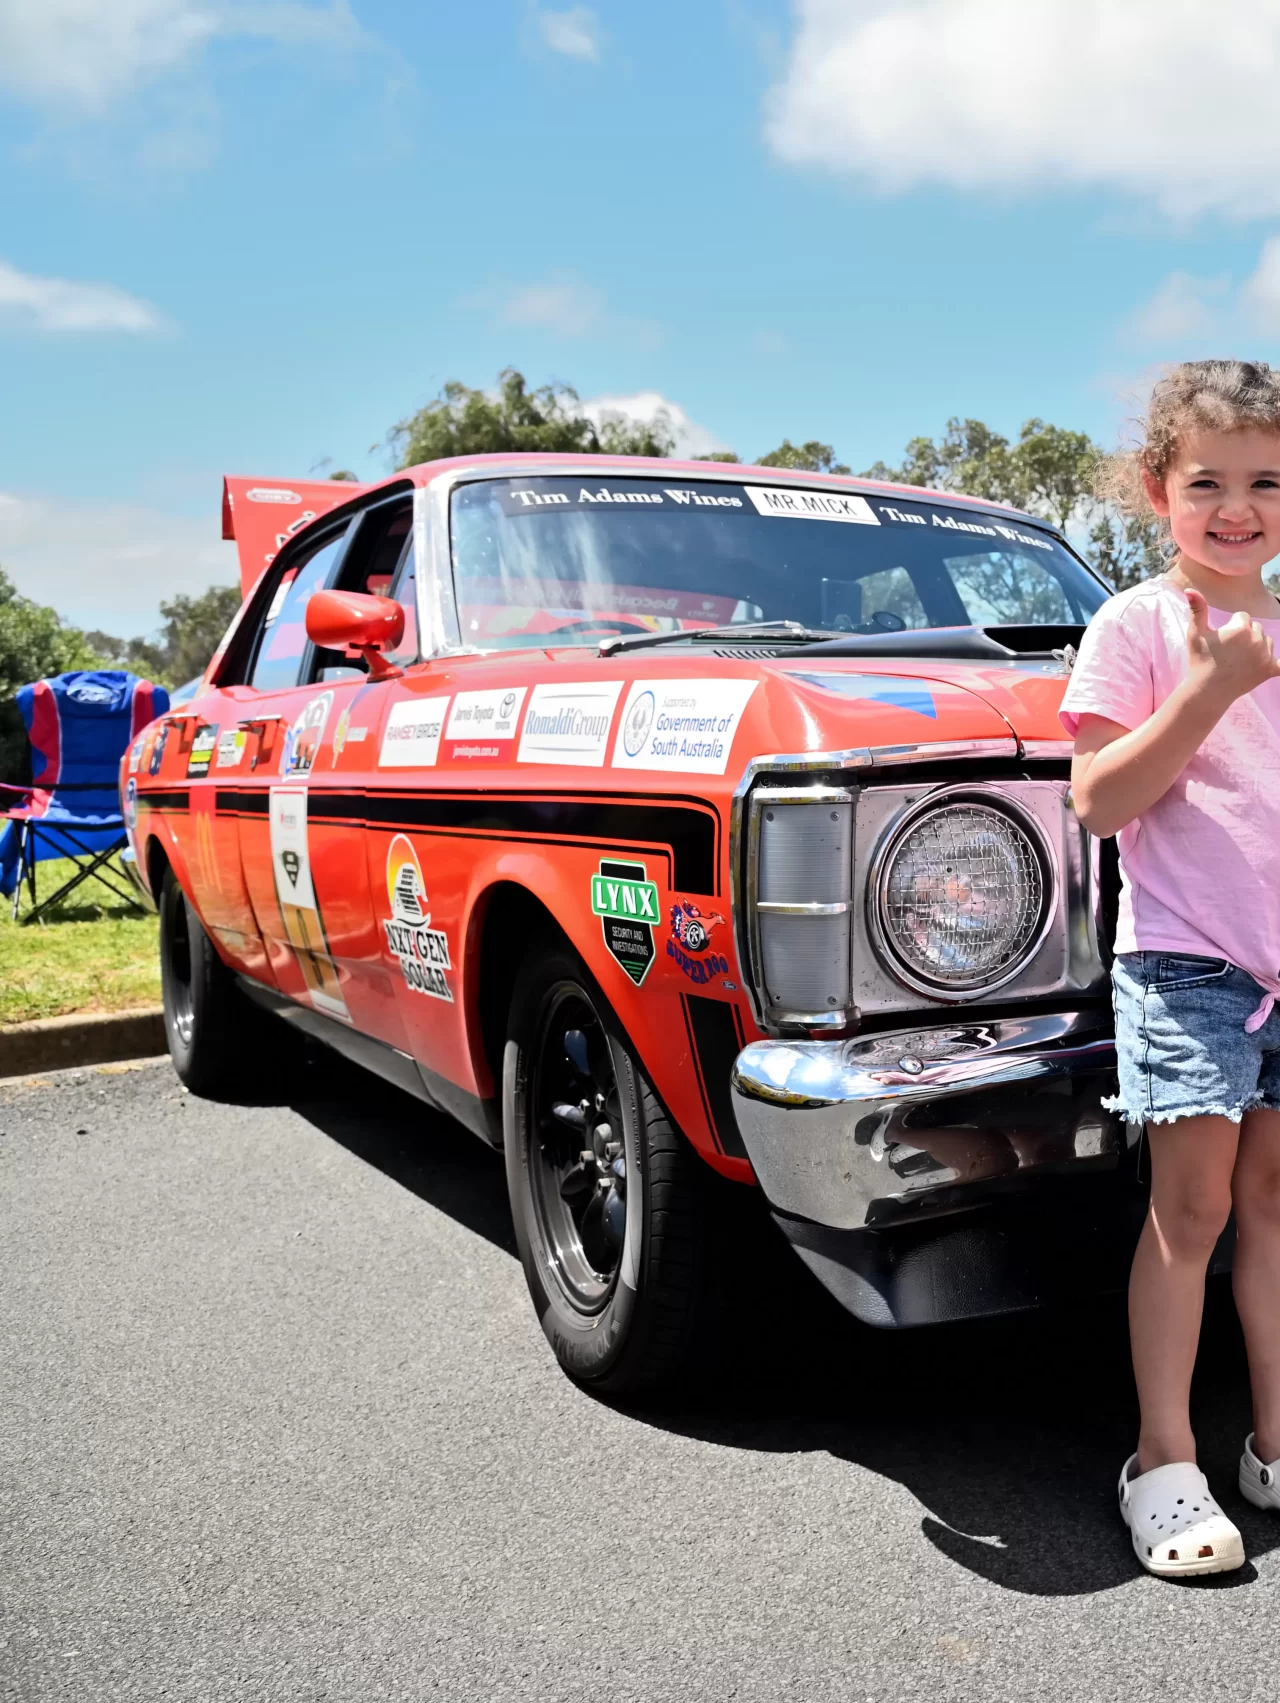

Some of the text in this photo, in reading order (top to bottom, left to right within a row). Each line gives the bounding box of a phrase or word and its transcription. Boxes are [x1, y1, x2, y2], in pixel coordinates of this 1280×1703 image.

[511, 488, 743, 507] Tim Adams Wines
[880, 506, 1053, 551] Tim Adams Wines
[472, 703, 495, 724] Toyota
[525, 707, 609, 742] RomaldiGroup
[656, 713, 734, 732] Government of
[651, 737, 724, 758] South Australia
[596, 881, 655, 917] LYNX
[612, 926, 644, 941] SECURITY AND
[416, 931, 449, 965] GEN
[612, 940, 649, 956] INVESTIGATIONS
[667, 939, 729, 985] SUPER ROO
[402, 959, 452, 998] SOLAR
